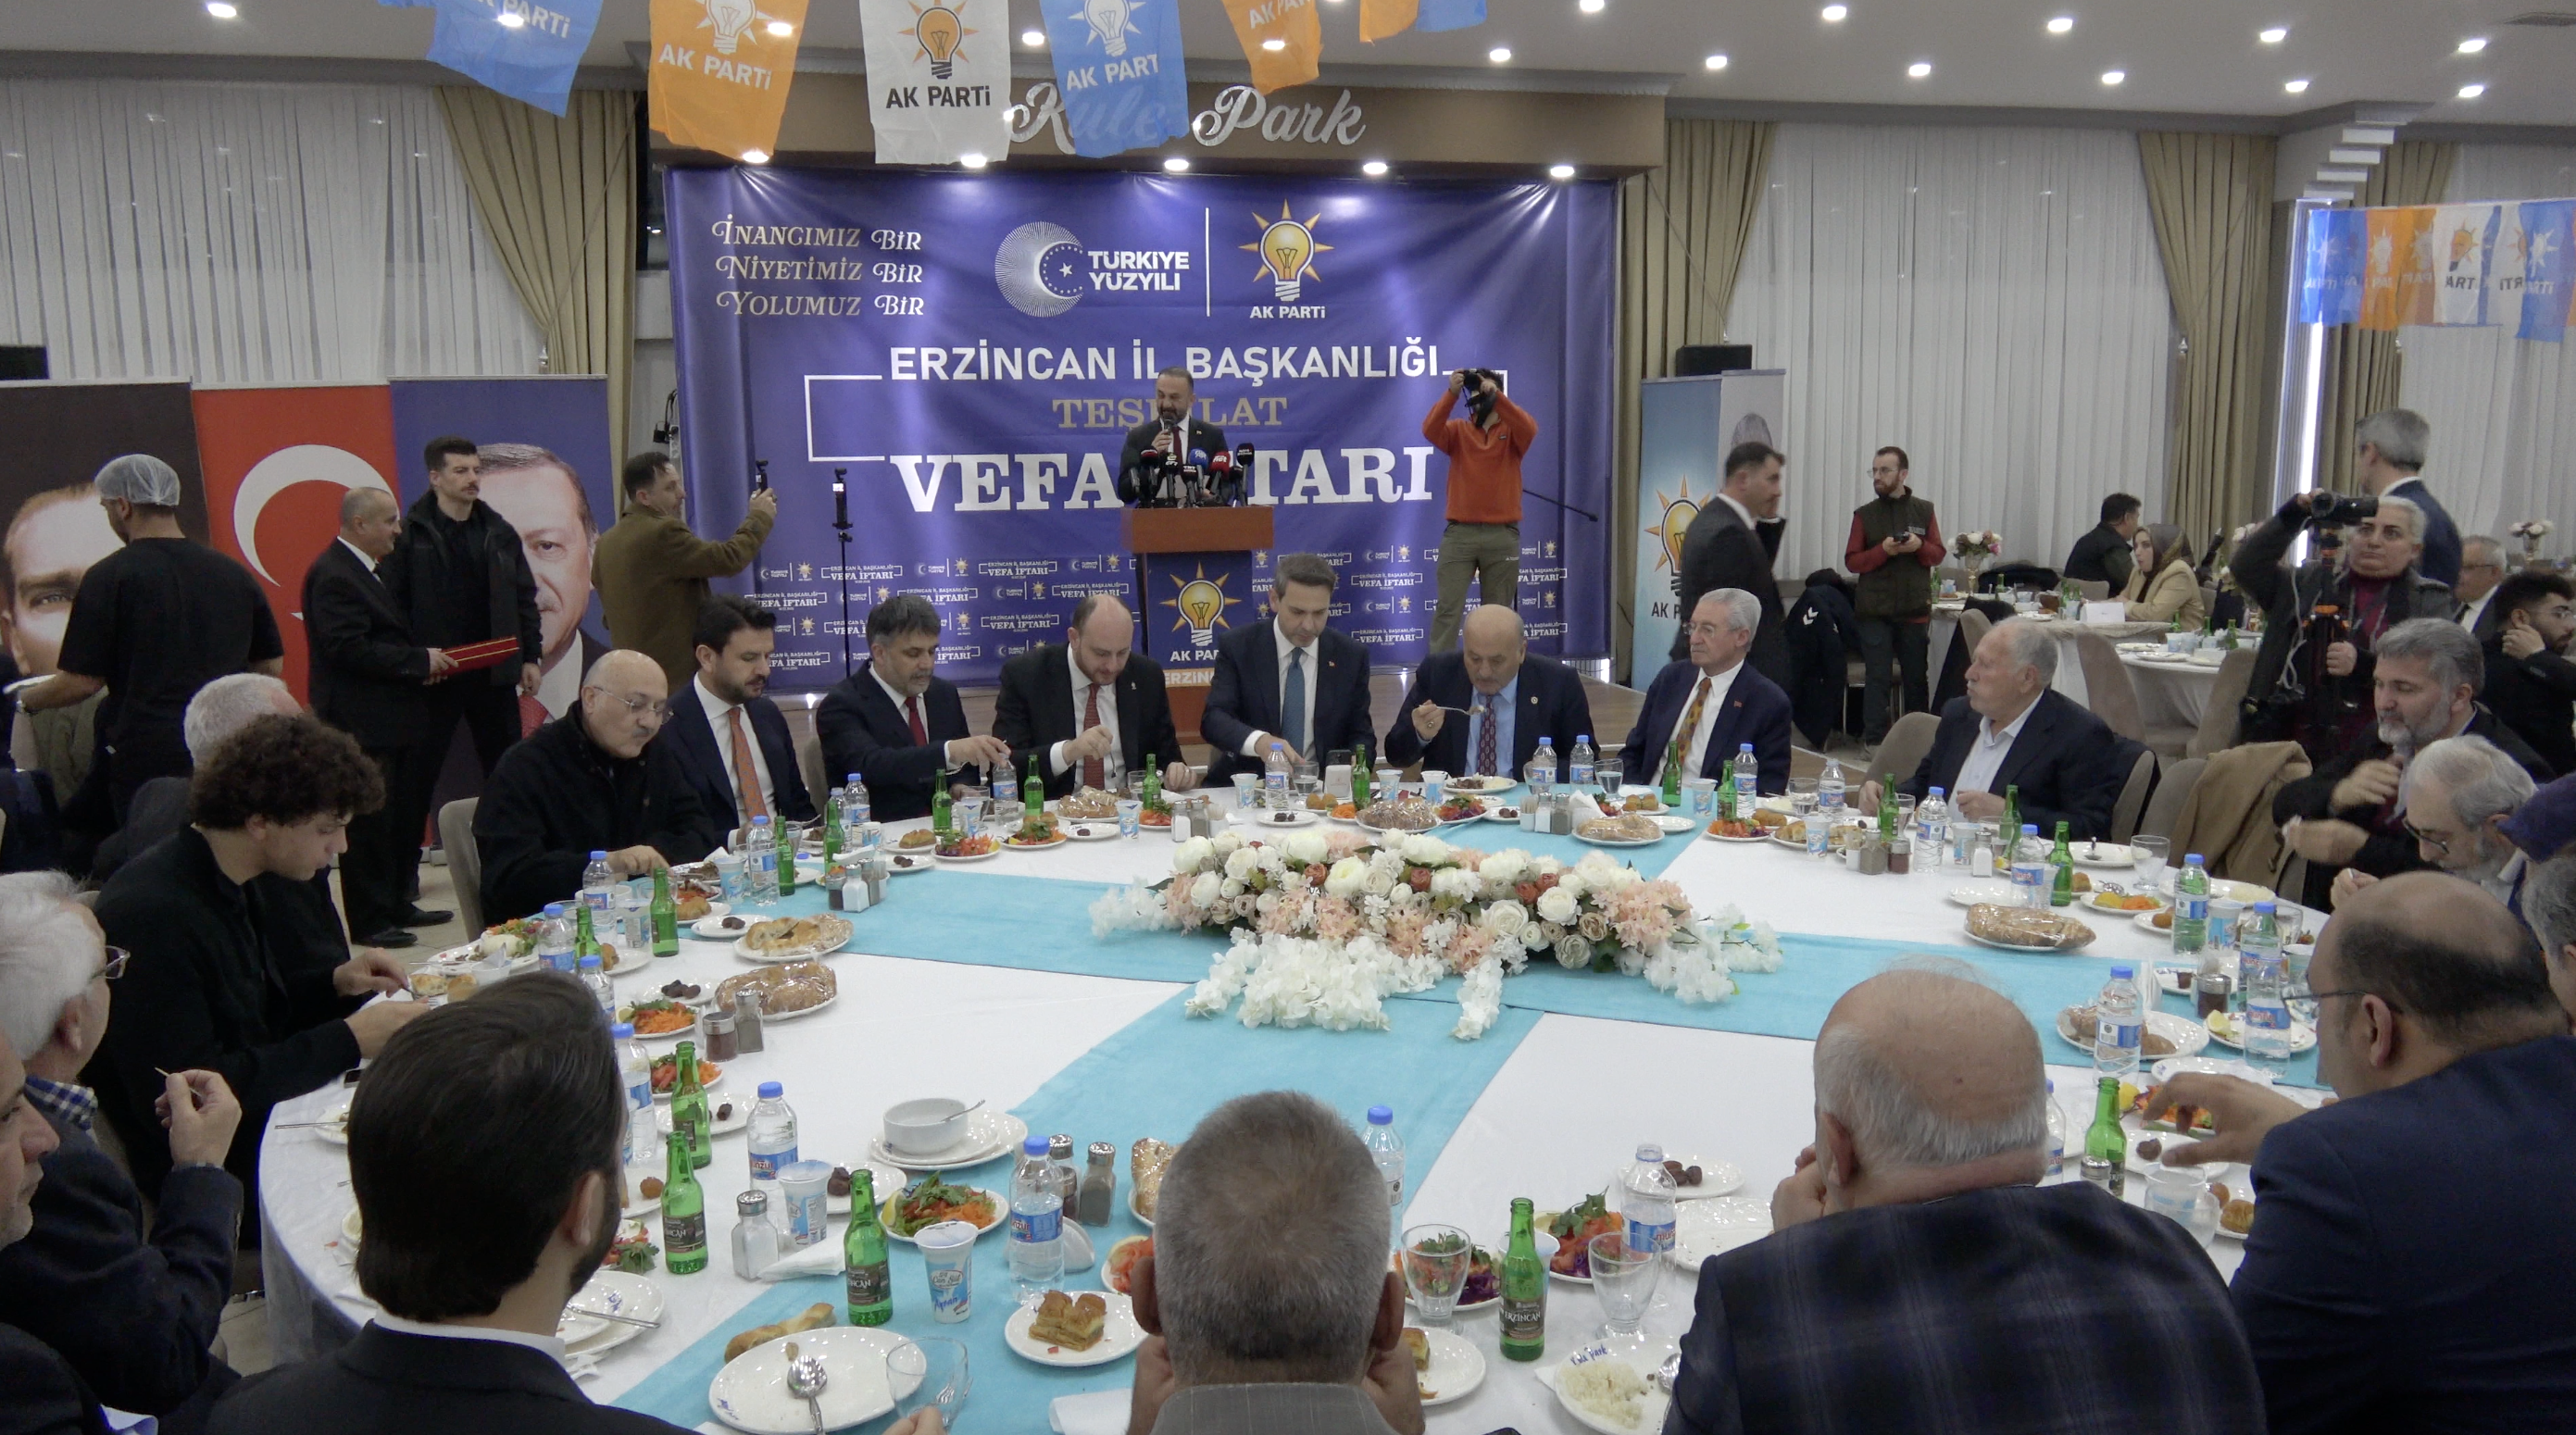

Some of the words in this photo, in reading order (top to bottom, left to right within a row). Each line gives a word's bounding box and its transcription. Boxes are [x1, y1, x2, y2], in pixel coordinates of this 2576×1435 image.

[1249, 2, 1276, 29] AK
[658, 44, 693, 71] AK
[1067, 67, 1098, 91] AK
[1105, 54, 1158, 83] PART
[886, 87, 919, 108] AK
[1193, 85, 1365, 146] Park
[717, 292, 861, 316] YOLUMUZ
[1250, 306, 1274, 318] AK
[891, 339, 1115, 381] ERZİNCAN
[1133, 339, 1161, 380] İL
[1186, 337, 1437, 387] BAŞKANLIĞI
[1053, 397, 1287, 434] TEŞLAT
[890, 453, 1124, 513] VEFA
[1229, 446, 1433, 505] TARI
[859, 570, 894, 580] İFTARI
[1016, 566, 1049, 576] İFTARI
[1384, 578, 1414, 586] İFTARI
[783, 597, 817, 606] İFTARI
[935, 593, 969, 602] İFTARI
[1651, 602, 1668, 618] AK
[1018, 618, 1050, 629] İFTARI
[1385, 633, 1415, 642] İFTARI
[787, 657, 820, 667] İFTARI
[1169, 650, 1191, 662] AK
[1164, 671, 1214, 685] ERZİN
